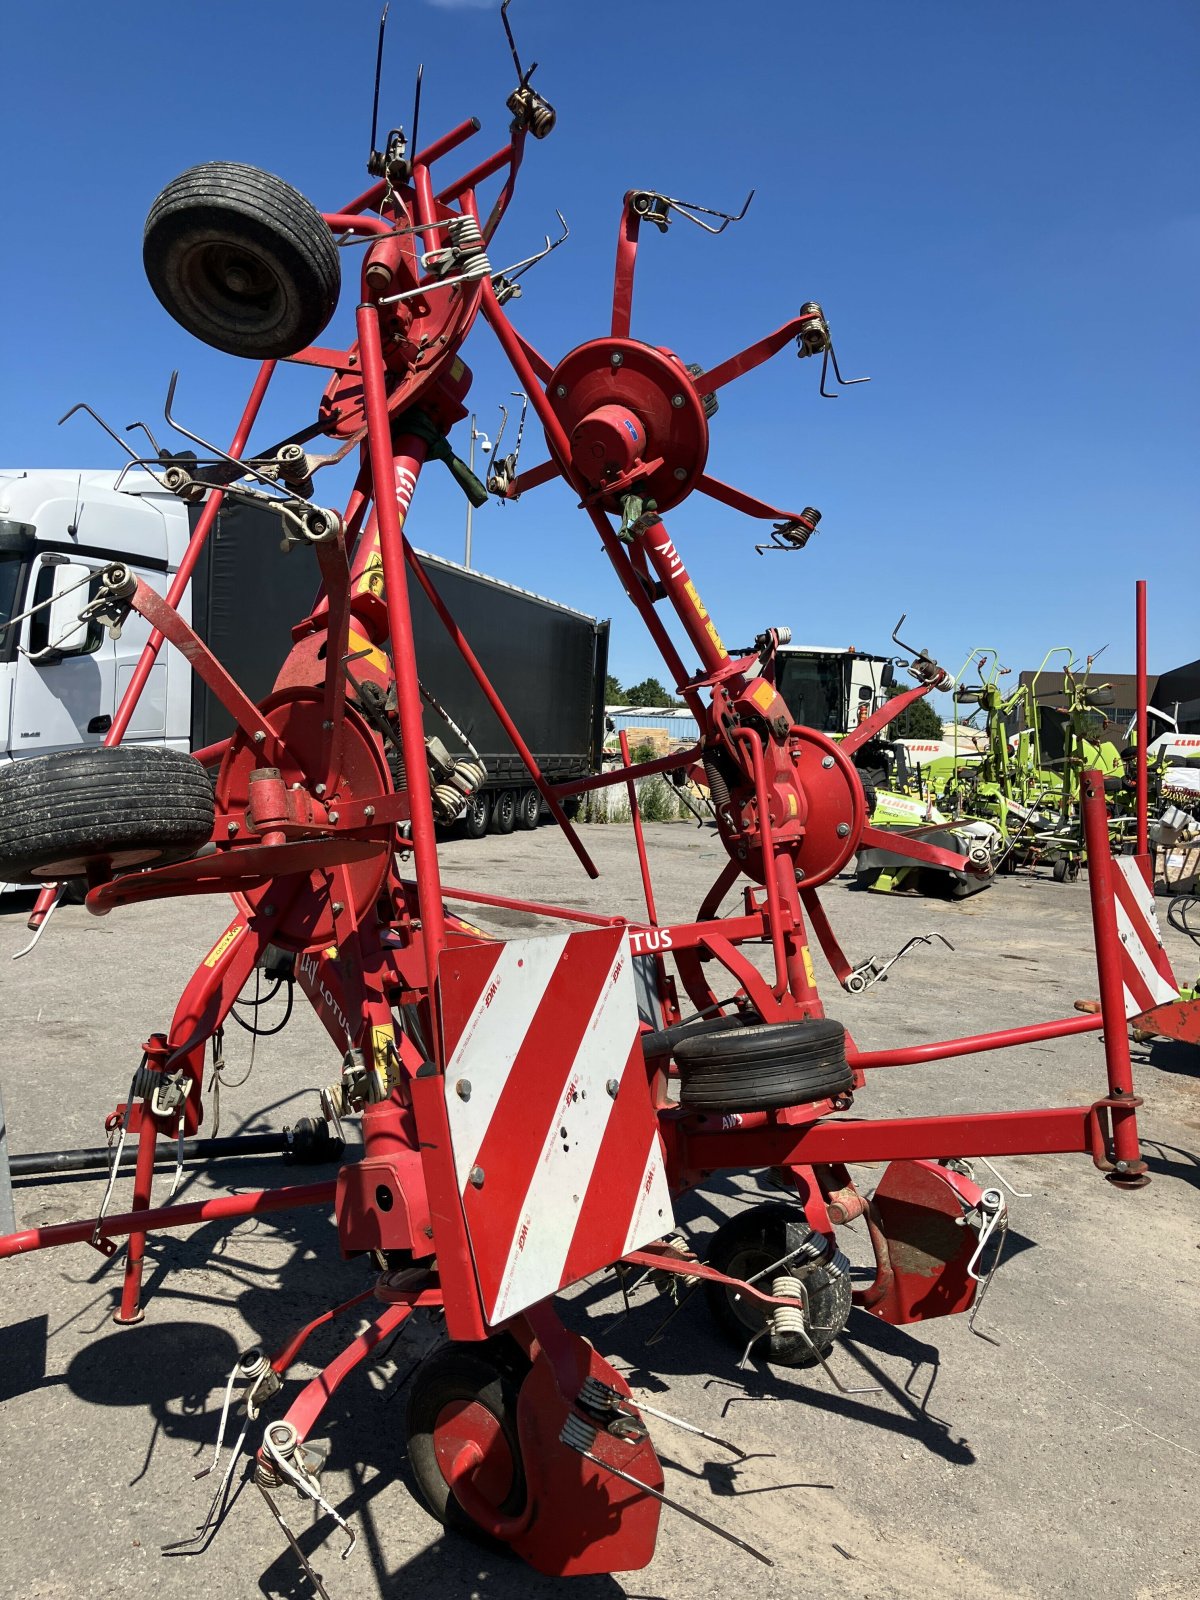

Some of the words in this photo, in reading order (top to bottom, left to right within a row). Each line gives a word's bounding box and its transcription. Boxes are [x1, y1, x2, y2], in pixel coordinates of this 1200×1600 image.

[396, 465, 417, 512] LELY
[653, 539, 686, 579] LELY
[879, 810, 899, 818] DISCO
[880, 798, 917, 811] CLAAS
[300, 954, 320, 987] LELY
[319, 980, 351, 1037] LOTUS
[485, 983, 498, 1009] WGF
